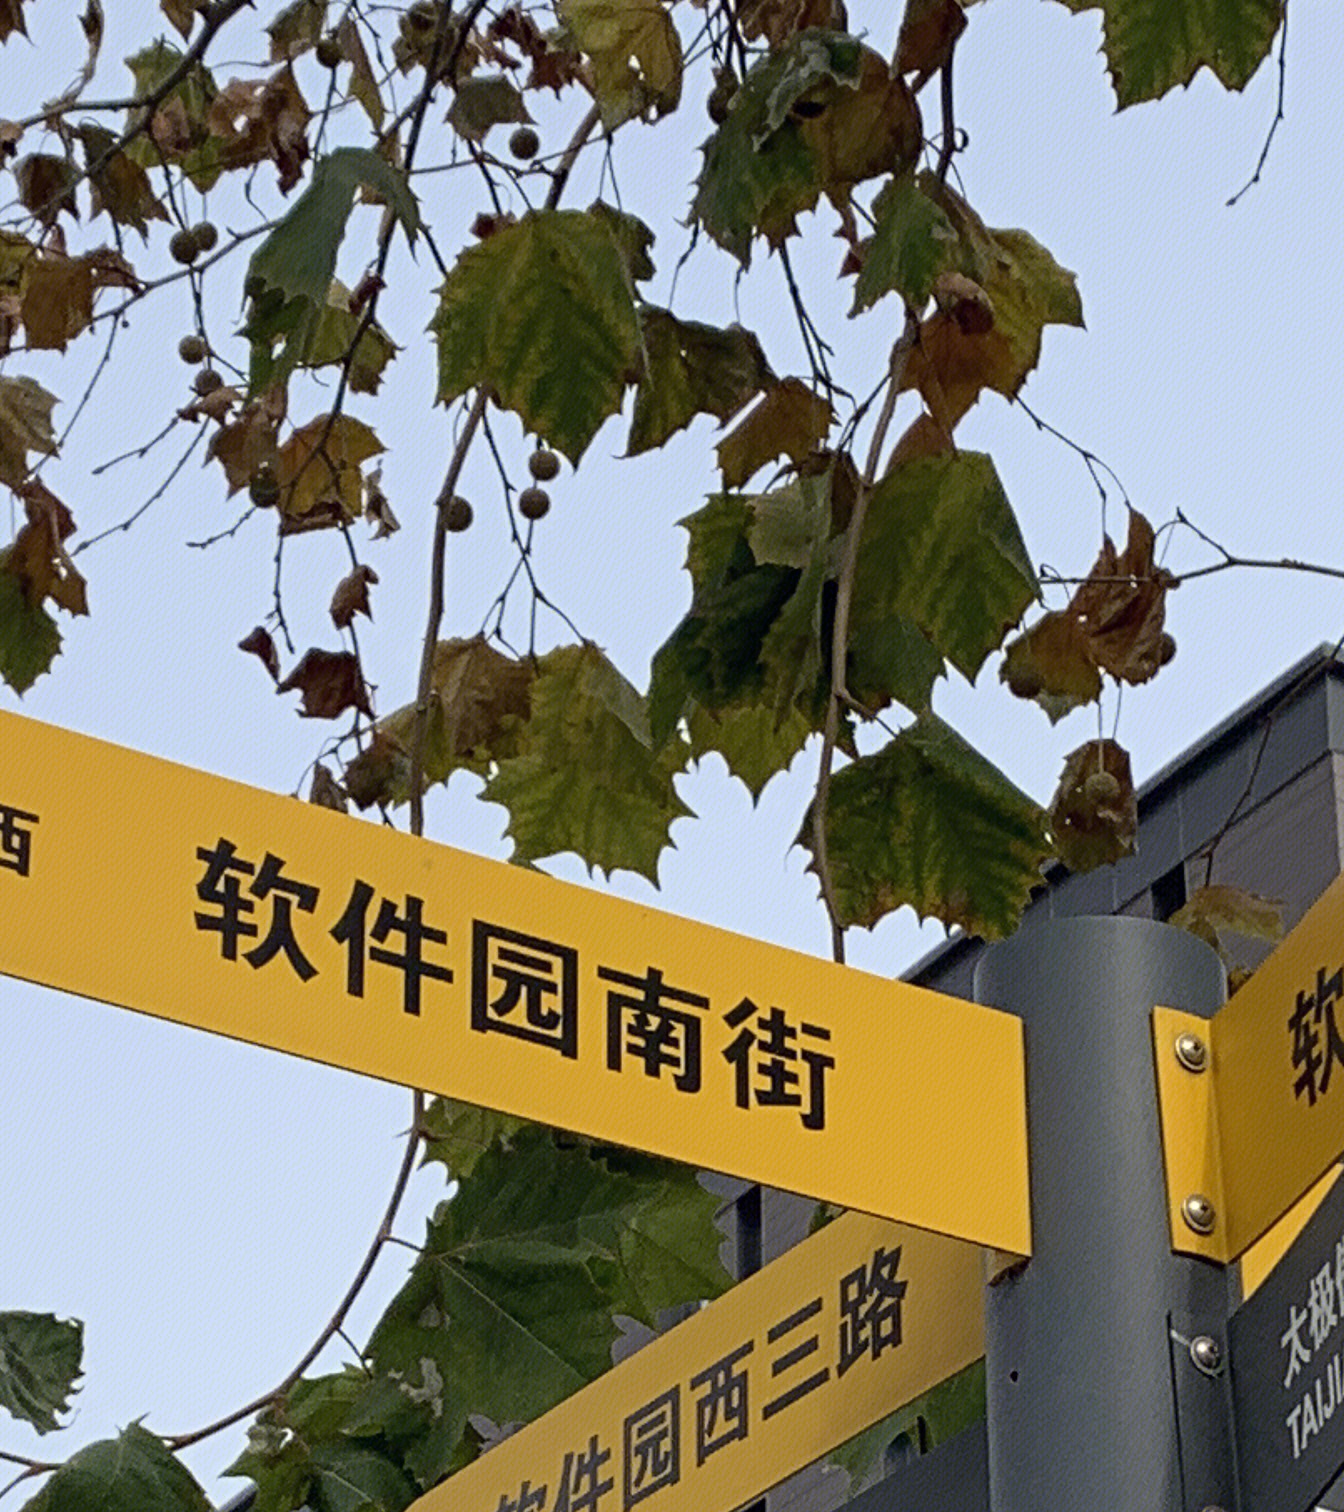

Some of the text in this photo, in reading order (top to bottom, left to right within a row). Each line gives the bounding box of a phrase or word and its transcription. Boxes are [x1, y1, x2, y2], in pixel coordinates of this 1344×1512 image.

[193, 837, 836, 1131] 软件园南街
